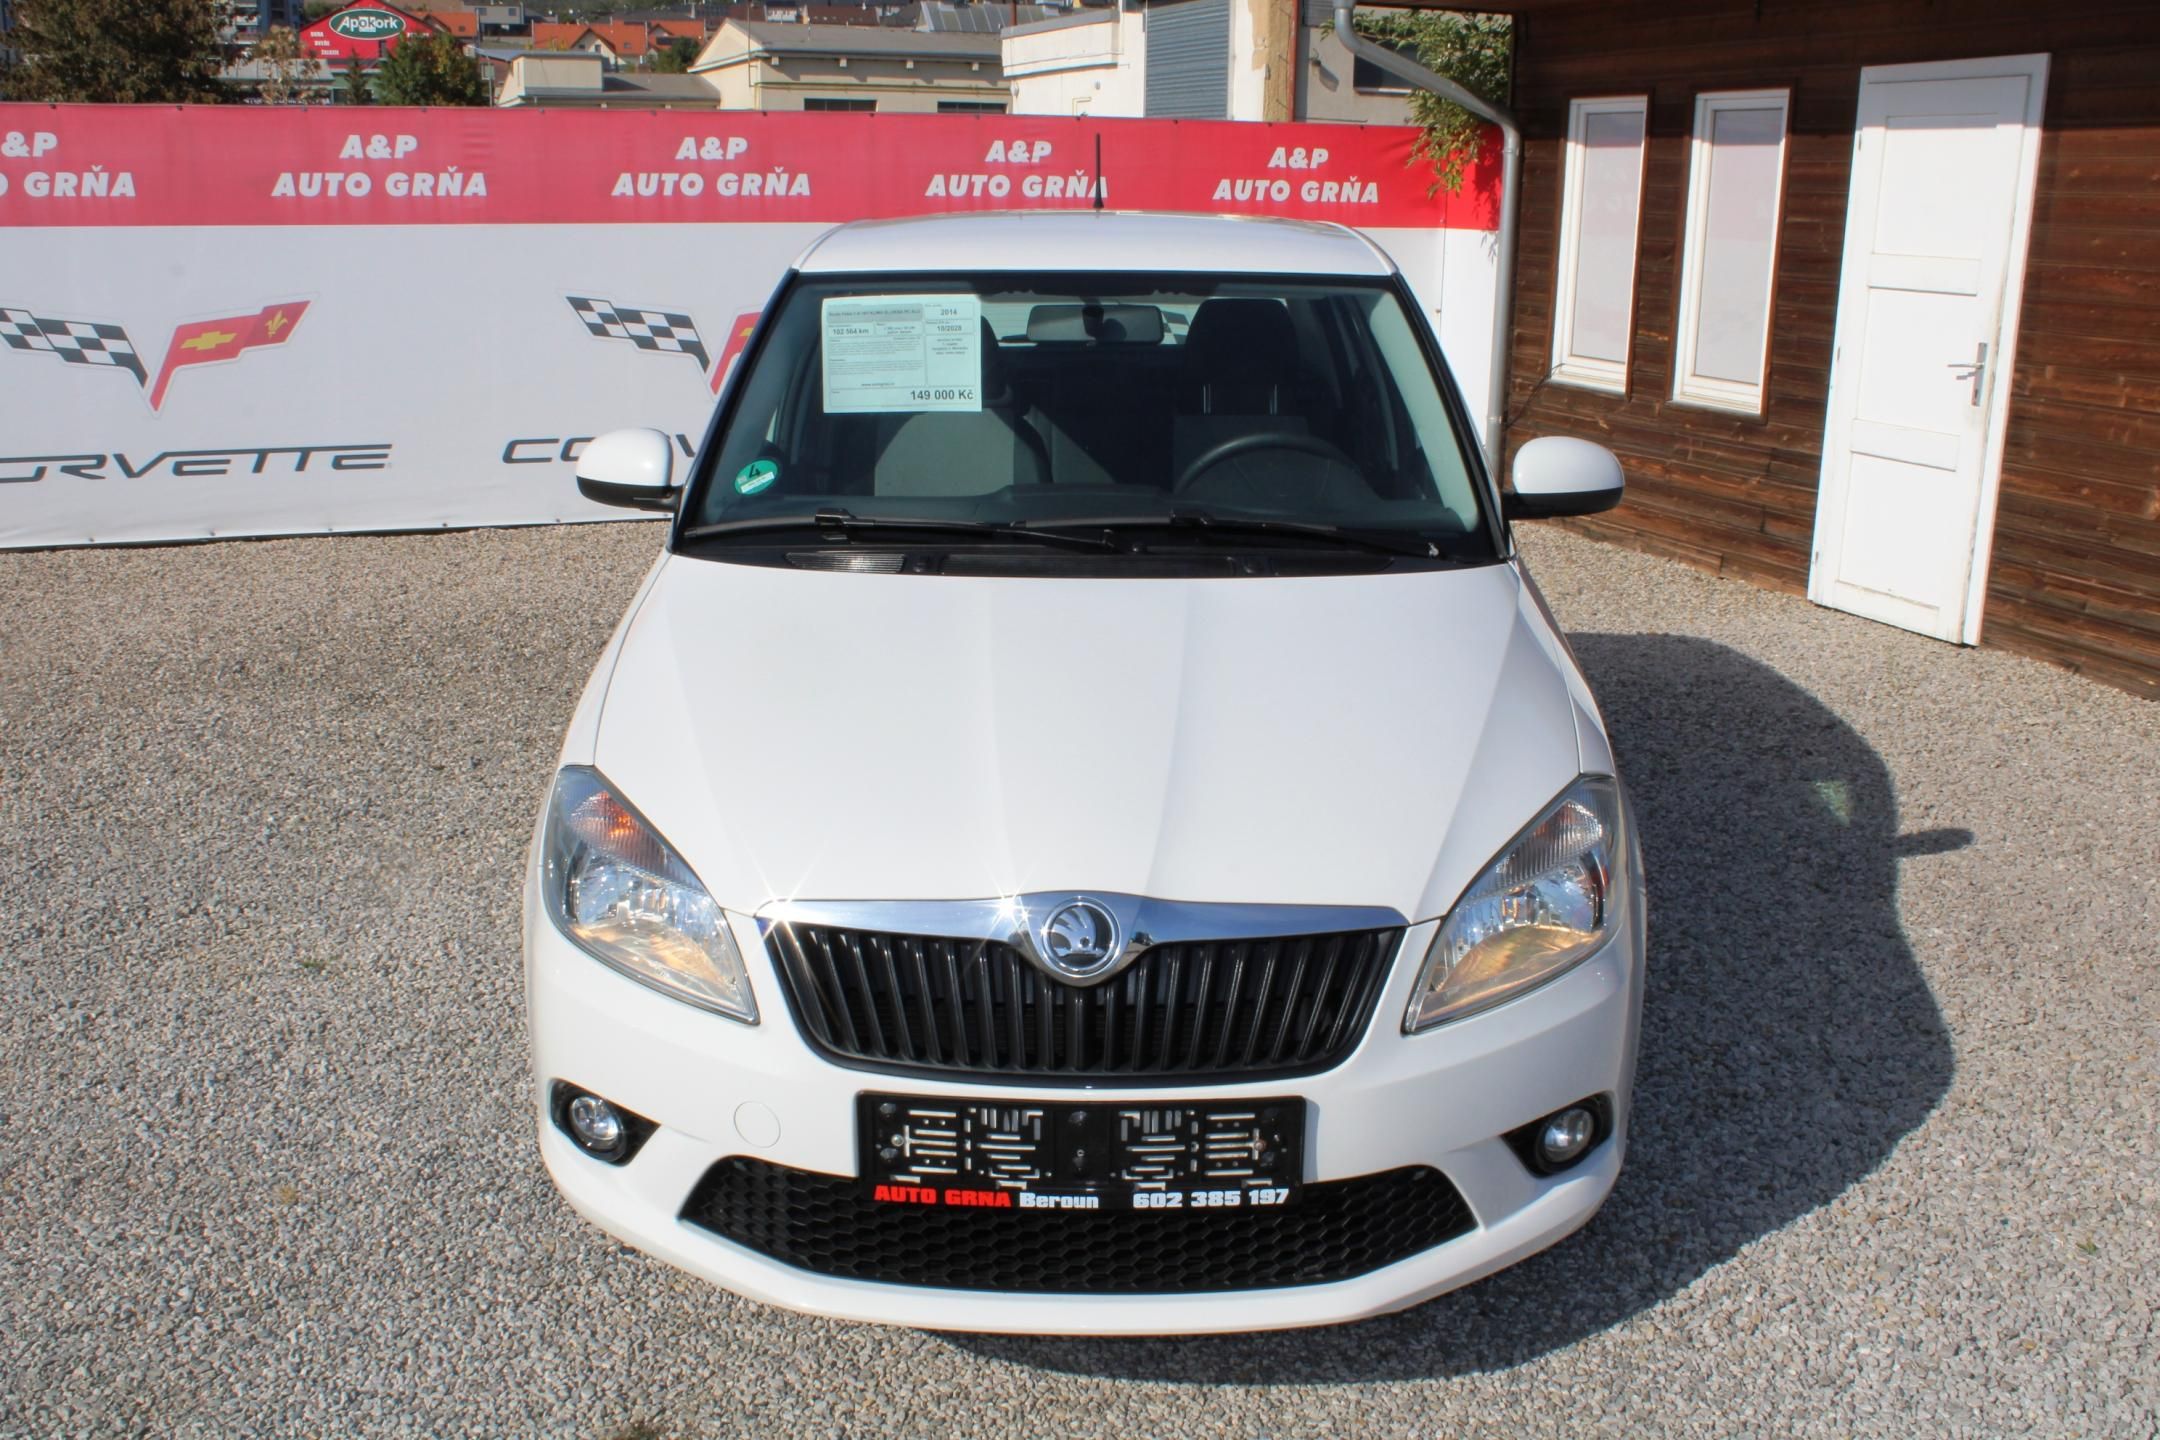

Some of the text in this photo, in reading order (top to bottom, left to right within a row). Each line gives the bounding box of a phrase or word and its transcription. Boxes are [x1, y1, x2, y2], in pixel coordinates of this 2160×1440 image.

[0, 131, 58, 158] &P
[340, 134, 418, 160] A&P
[675, 136, 748, 161] A&P
[984, 140, 1052, 163] A&P
[1267, 146, 1329, 169] A&P
[24, 164, 136, 197] GRŇA
[271, 165, 487, 198] AUTO GRŇA
[611, 166, 811, 197] AUTO GRŇA
[924, 168, 1109, 199] AUTO GRŇA
[1212, 175, 1379, 203] AUTO GRŇA
[910, 388, 974, 400] 149 000 Kč
[0, 444, 393, 484] ORVETTE
[749, 464, 760, 478] 4
[874, 1184, 937, 1204] AUTO
[1019, 1191, 1099, 1209] Beroun
[1133, 1192, 1183, 1209] 602
[1190, 1190, 1241, 1207] 385
[1249, 1188, 1289, 1206] 197
